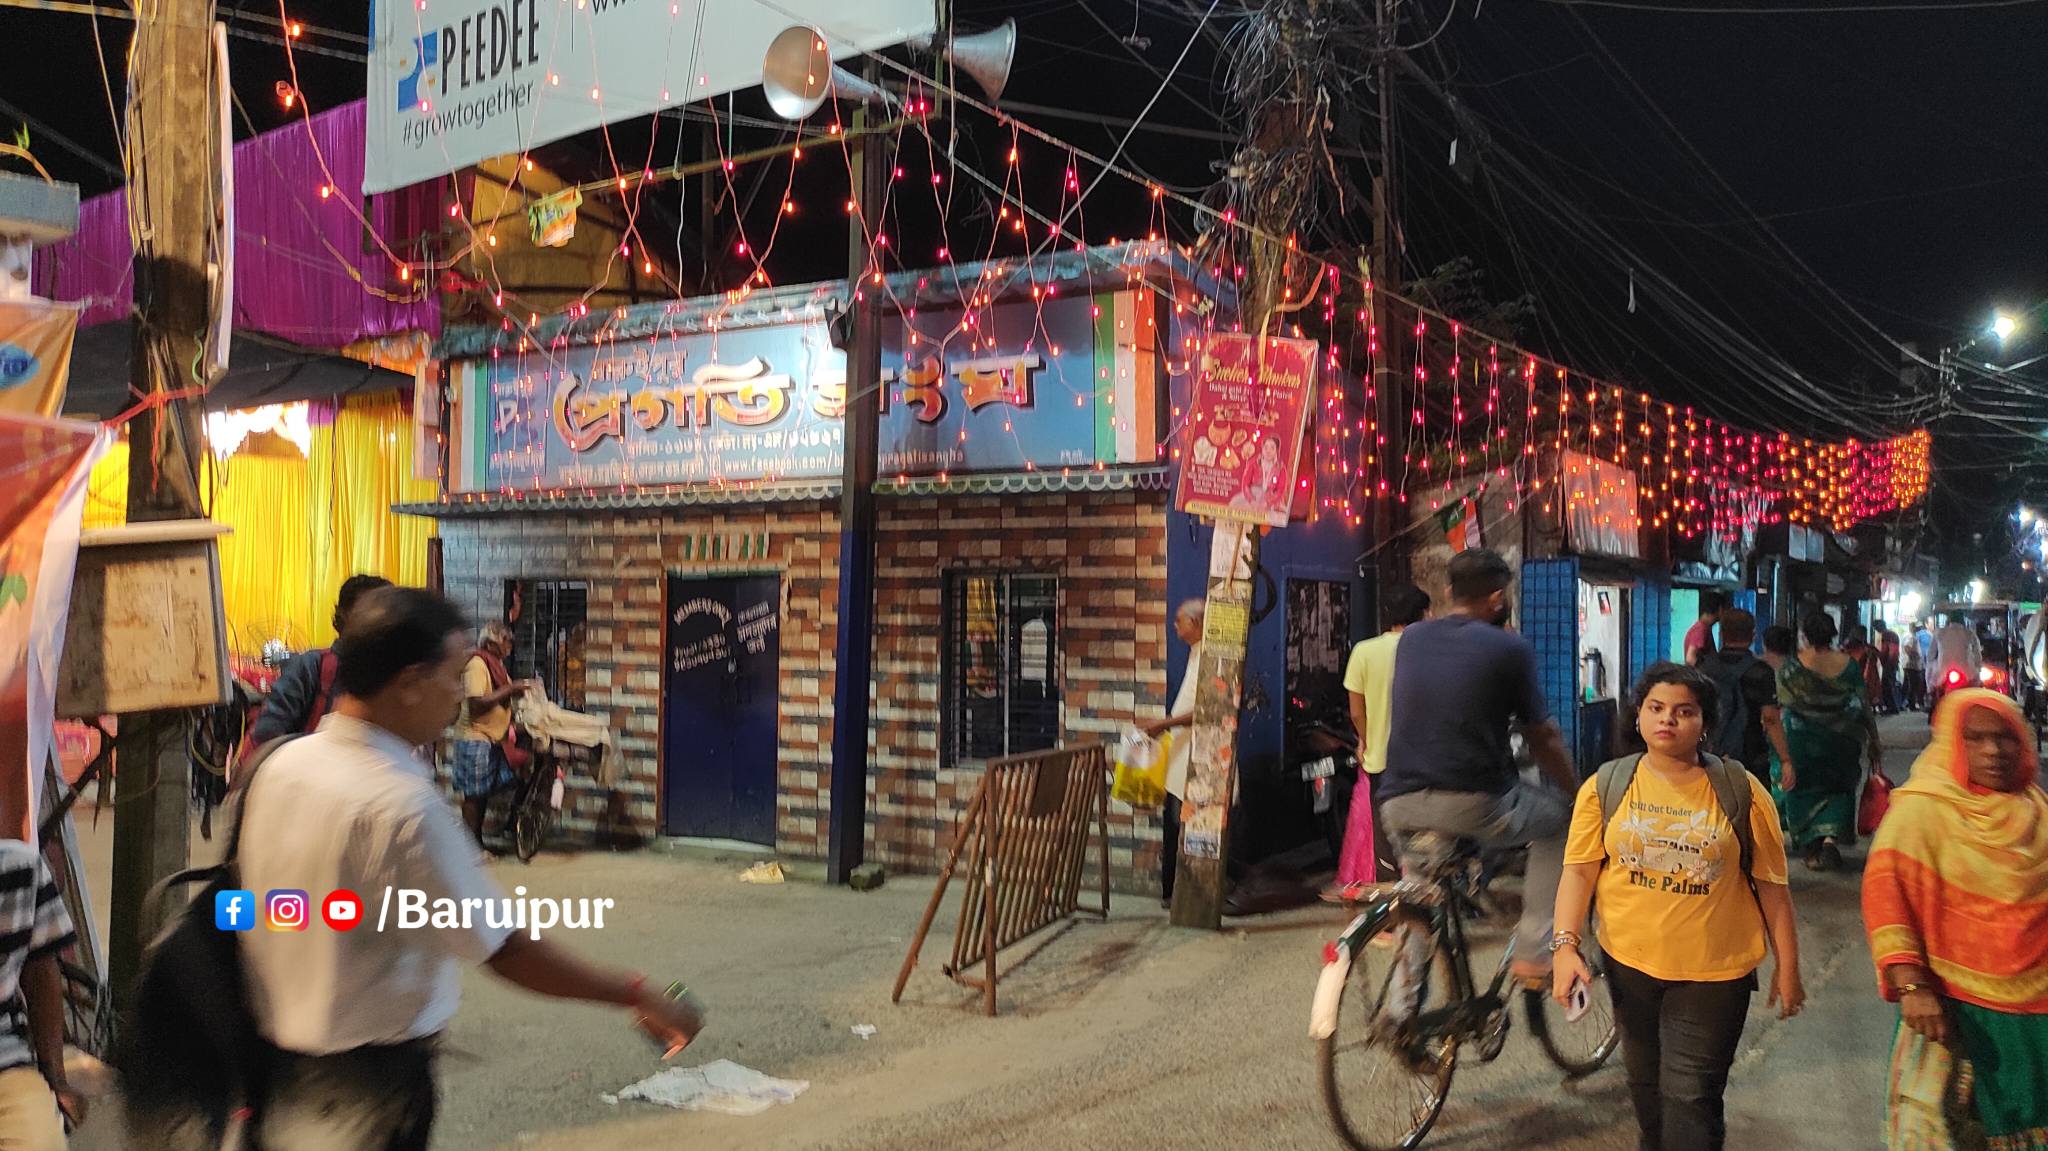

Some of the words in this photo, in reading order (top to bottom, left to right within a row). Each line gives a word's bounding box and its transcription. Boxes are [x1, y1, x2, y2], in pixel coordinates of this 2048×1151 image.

[442, 0, 540, 97] PEEDEE
[403, 80, 534, 149] #growtogether
[1648, 803, 1665, 814] Out
[1666, 805, 1693, 817] Under
[1629, 870, 1657, 889] The
[1661, 875, 1710, 896] Palms
